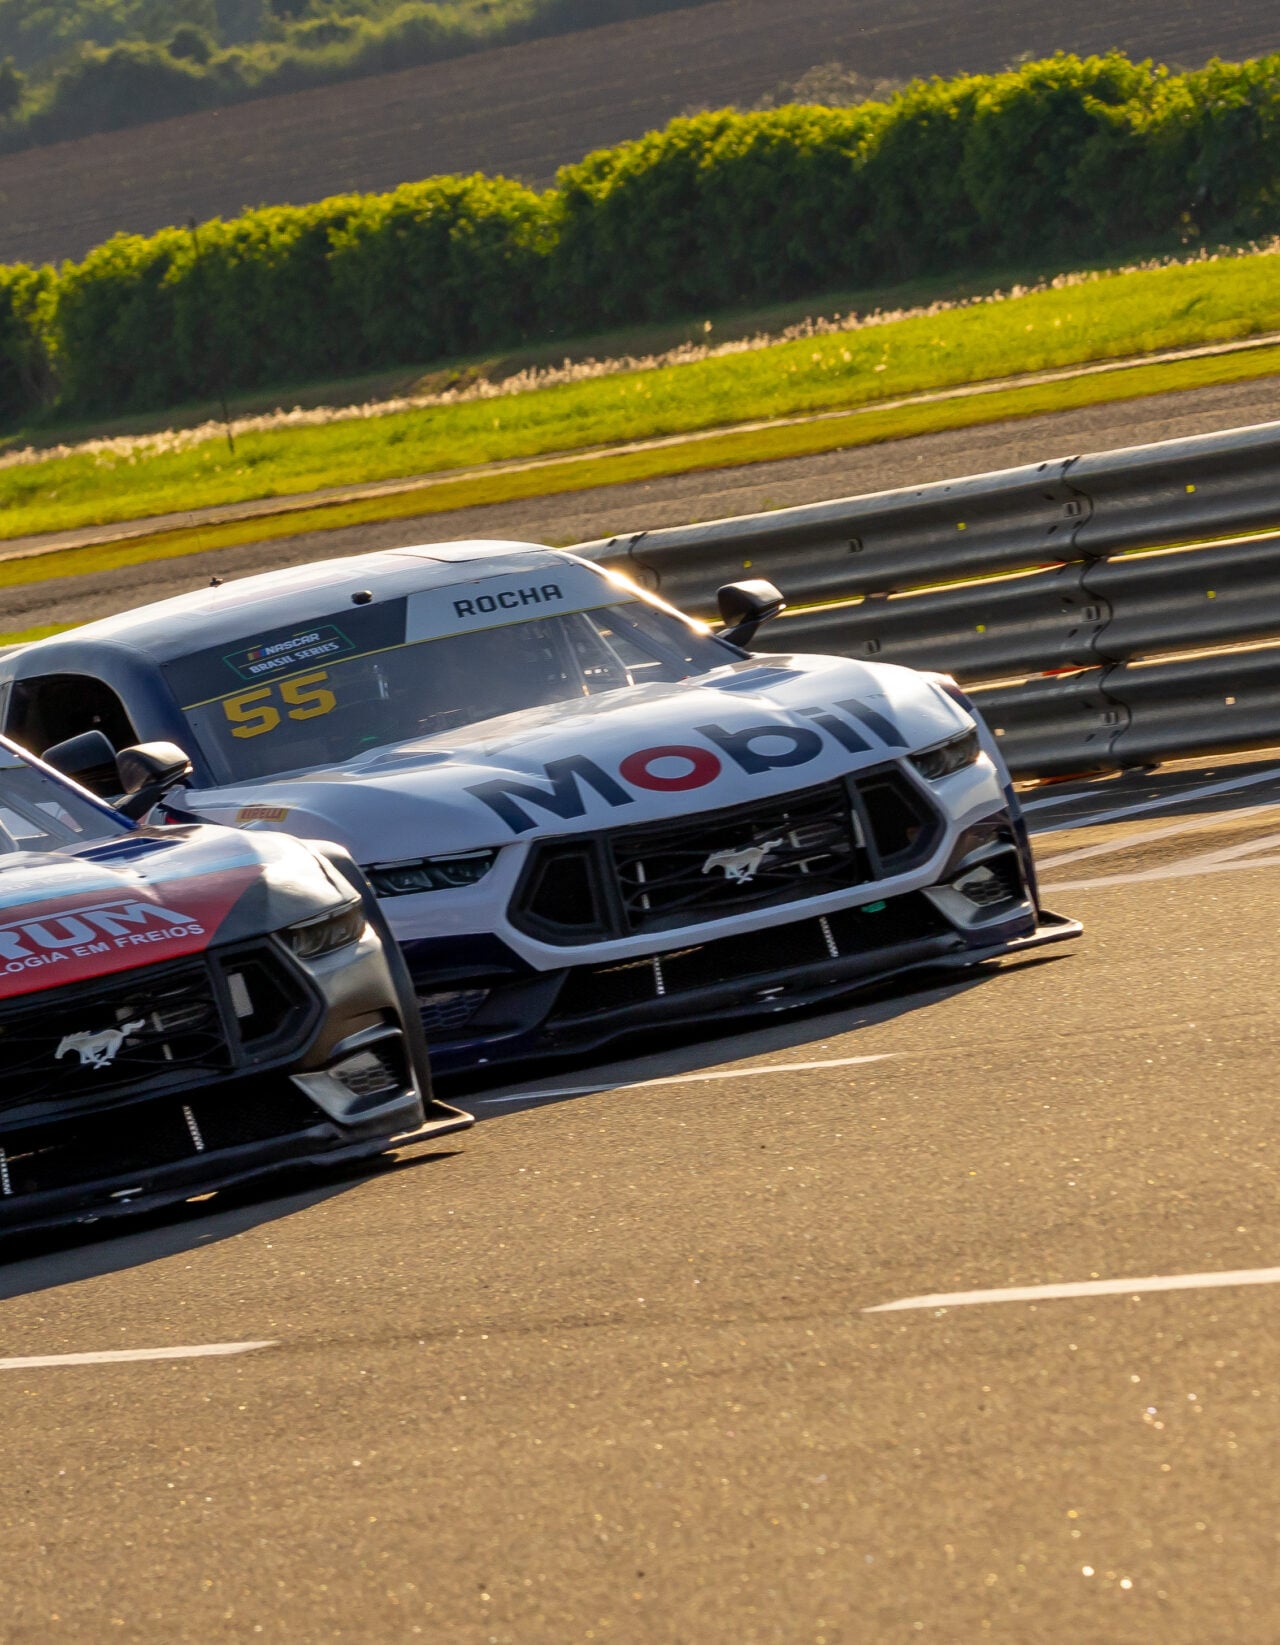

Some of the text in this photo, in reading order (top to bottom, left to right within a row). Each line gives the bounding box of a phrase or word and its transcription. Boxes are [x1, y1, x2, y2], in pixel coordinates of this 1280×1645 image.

[453, 583, 564, 618] ROCHA
[249, 642, 340, 674] BRASIL SERIES
[264, 633, 321, 655] NASCAR
[222, 671, 337, 738] 55
[463, 697, 909, 835] Mobil
[71, 941, 111, 958] EM
[116, 924, 206, 949] FREIOS
